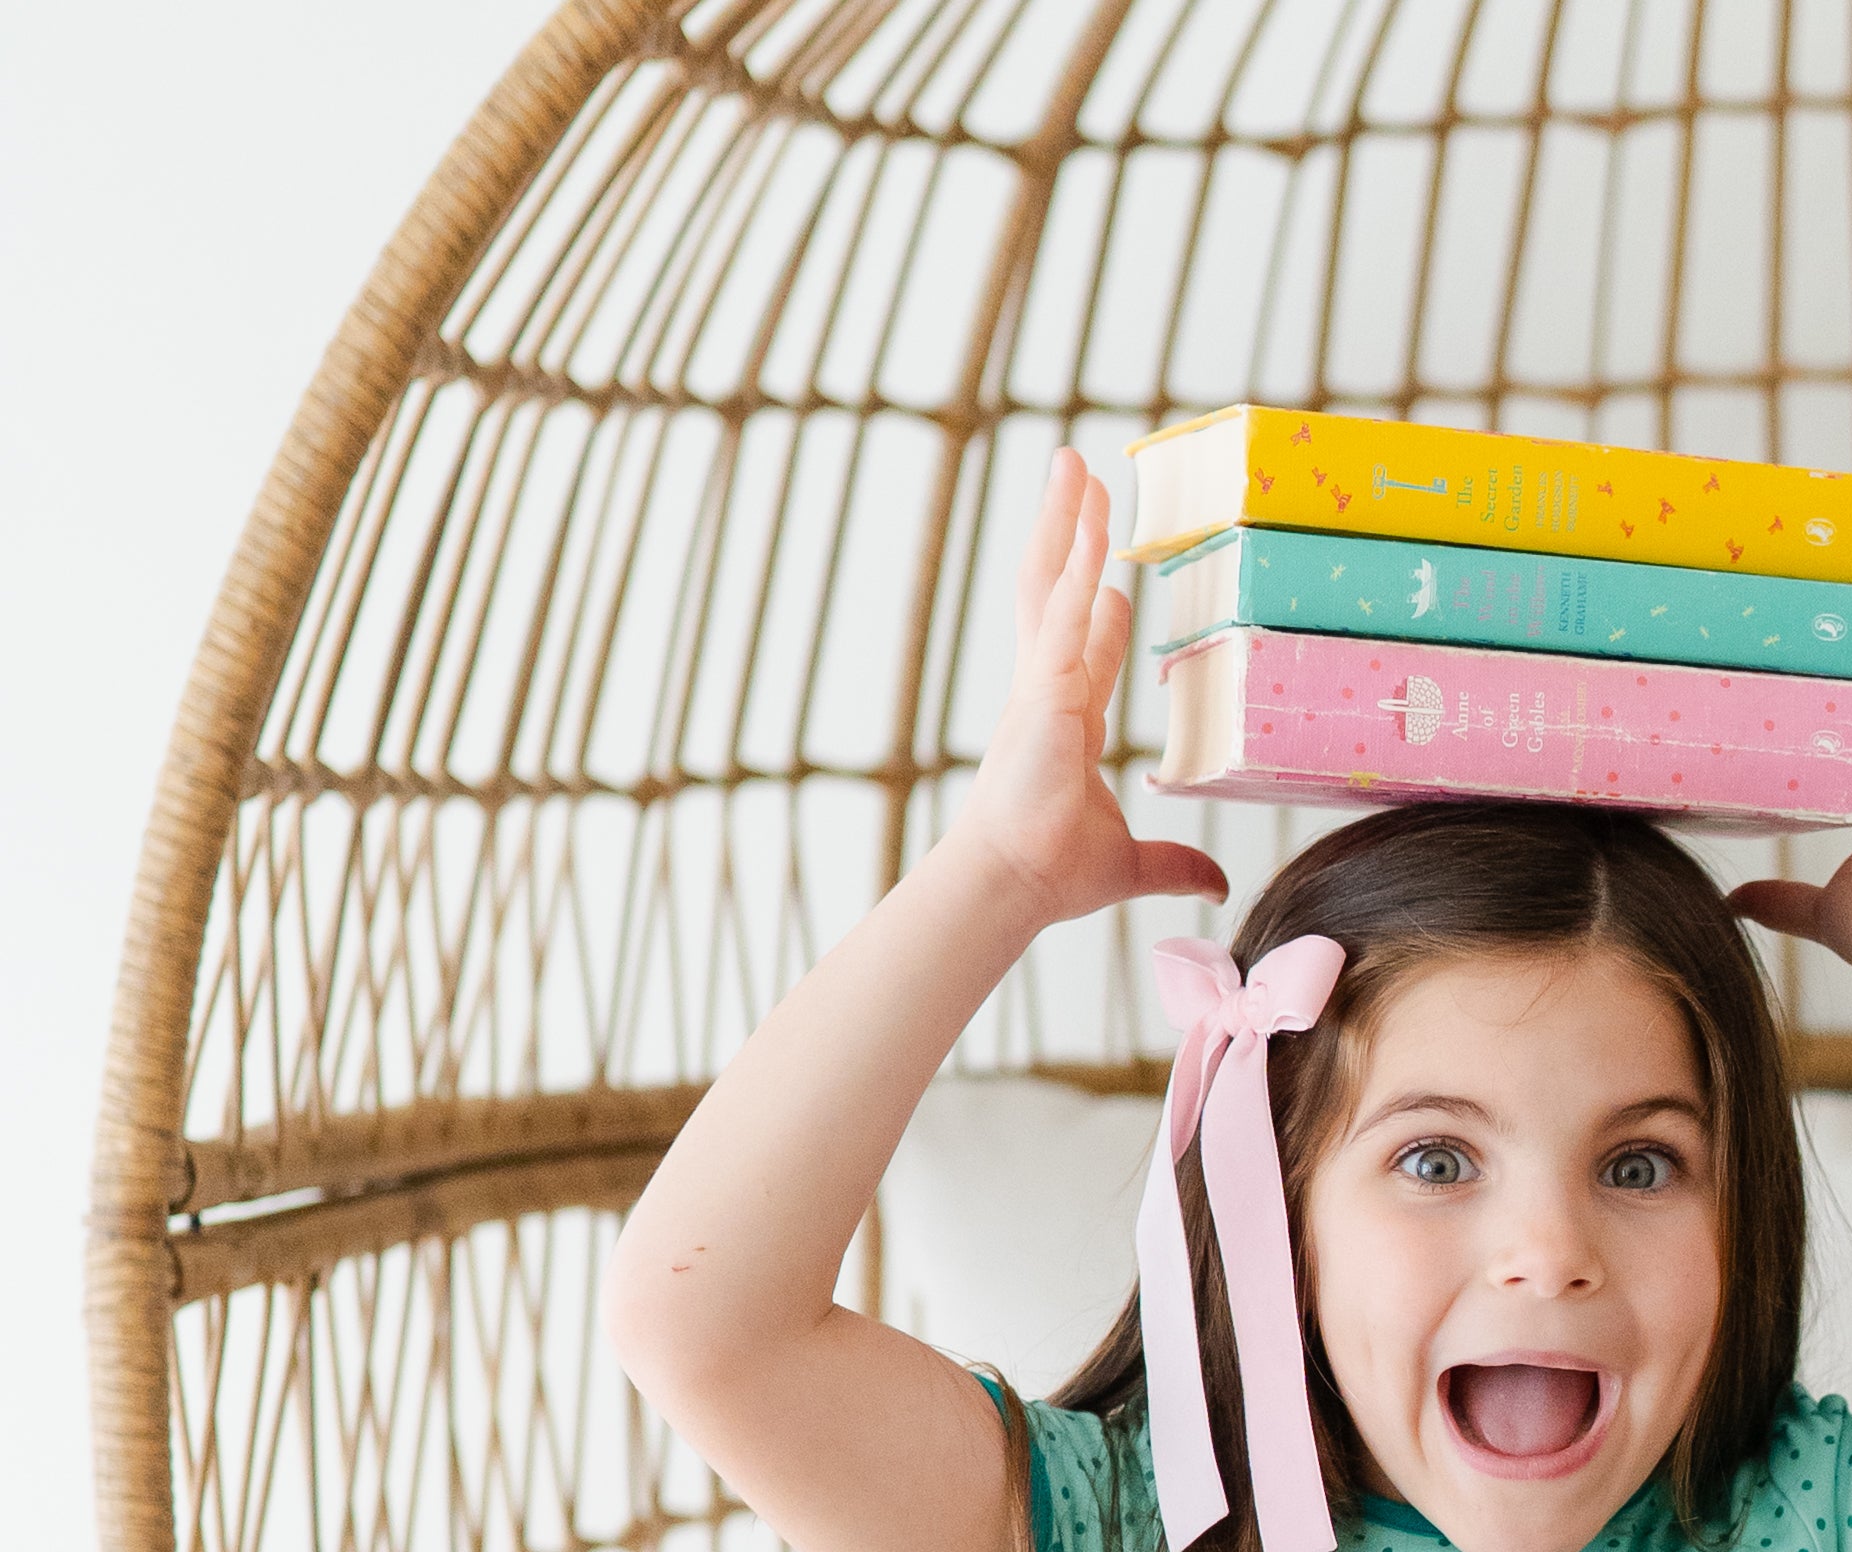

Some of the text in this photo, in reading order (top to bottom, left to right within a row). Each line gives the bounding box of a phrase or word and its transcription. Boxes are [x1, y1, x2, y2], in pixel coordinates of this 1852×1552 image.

[1457, 476, 1473, 509] The
[1481, 468, 1498, 524] Secret
[1504, 465, 1523, 532] Garden
[1453, 576, 1472, 609] The
[1478, 570, 1497, 621] Wind
[1558, 571, 1572, 633] KENNETH
[1575, 572, 1588, 636] GRAHAME
[1452, 691, 1469, 742] Anne
[1478, 704, 1495, 727] of
[1502, 692, 1521, 748] Green
[1527, 691, 1546, 753] Gables
